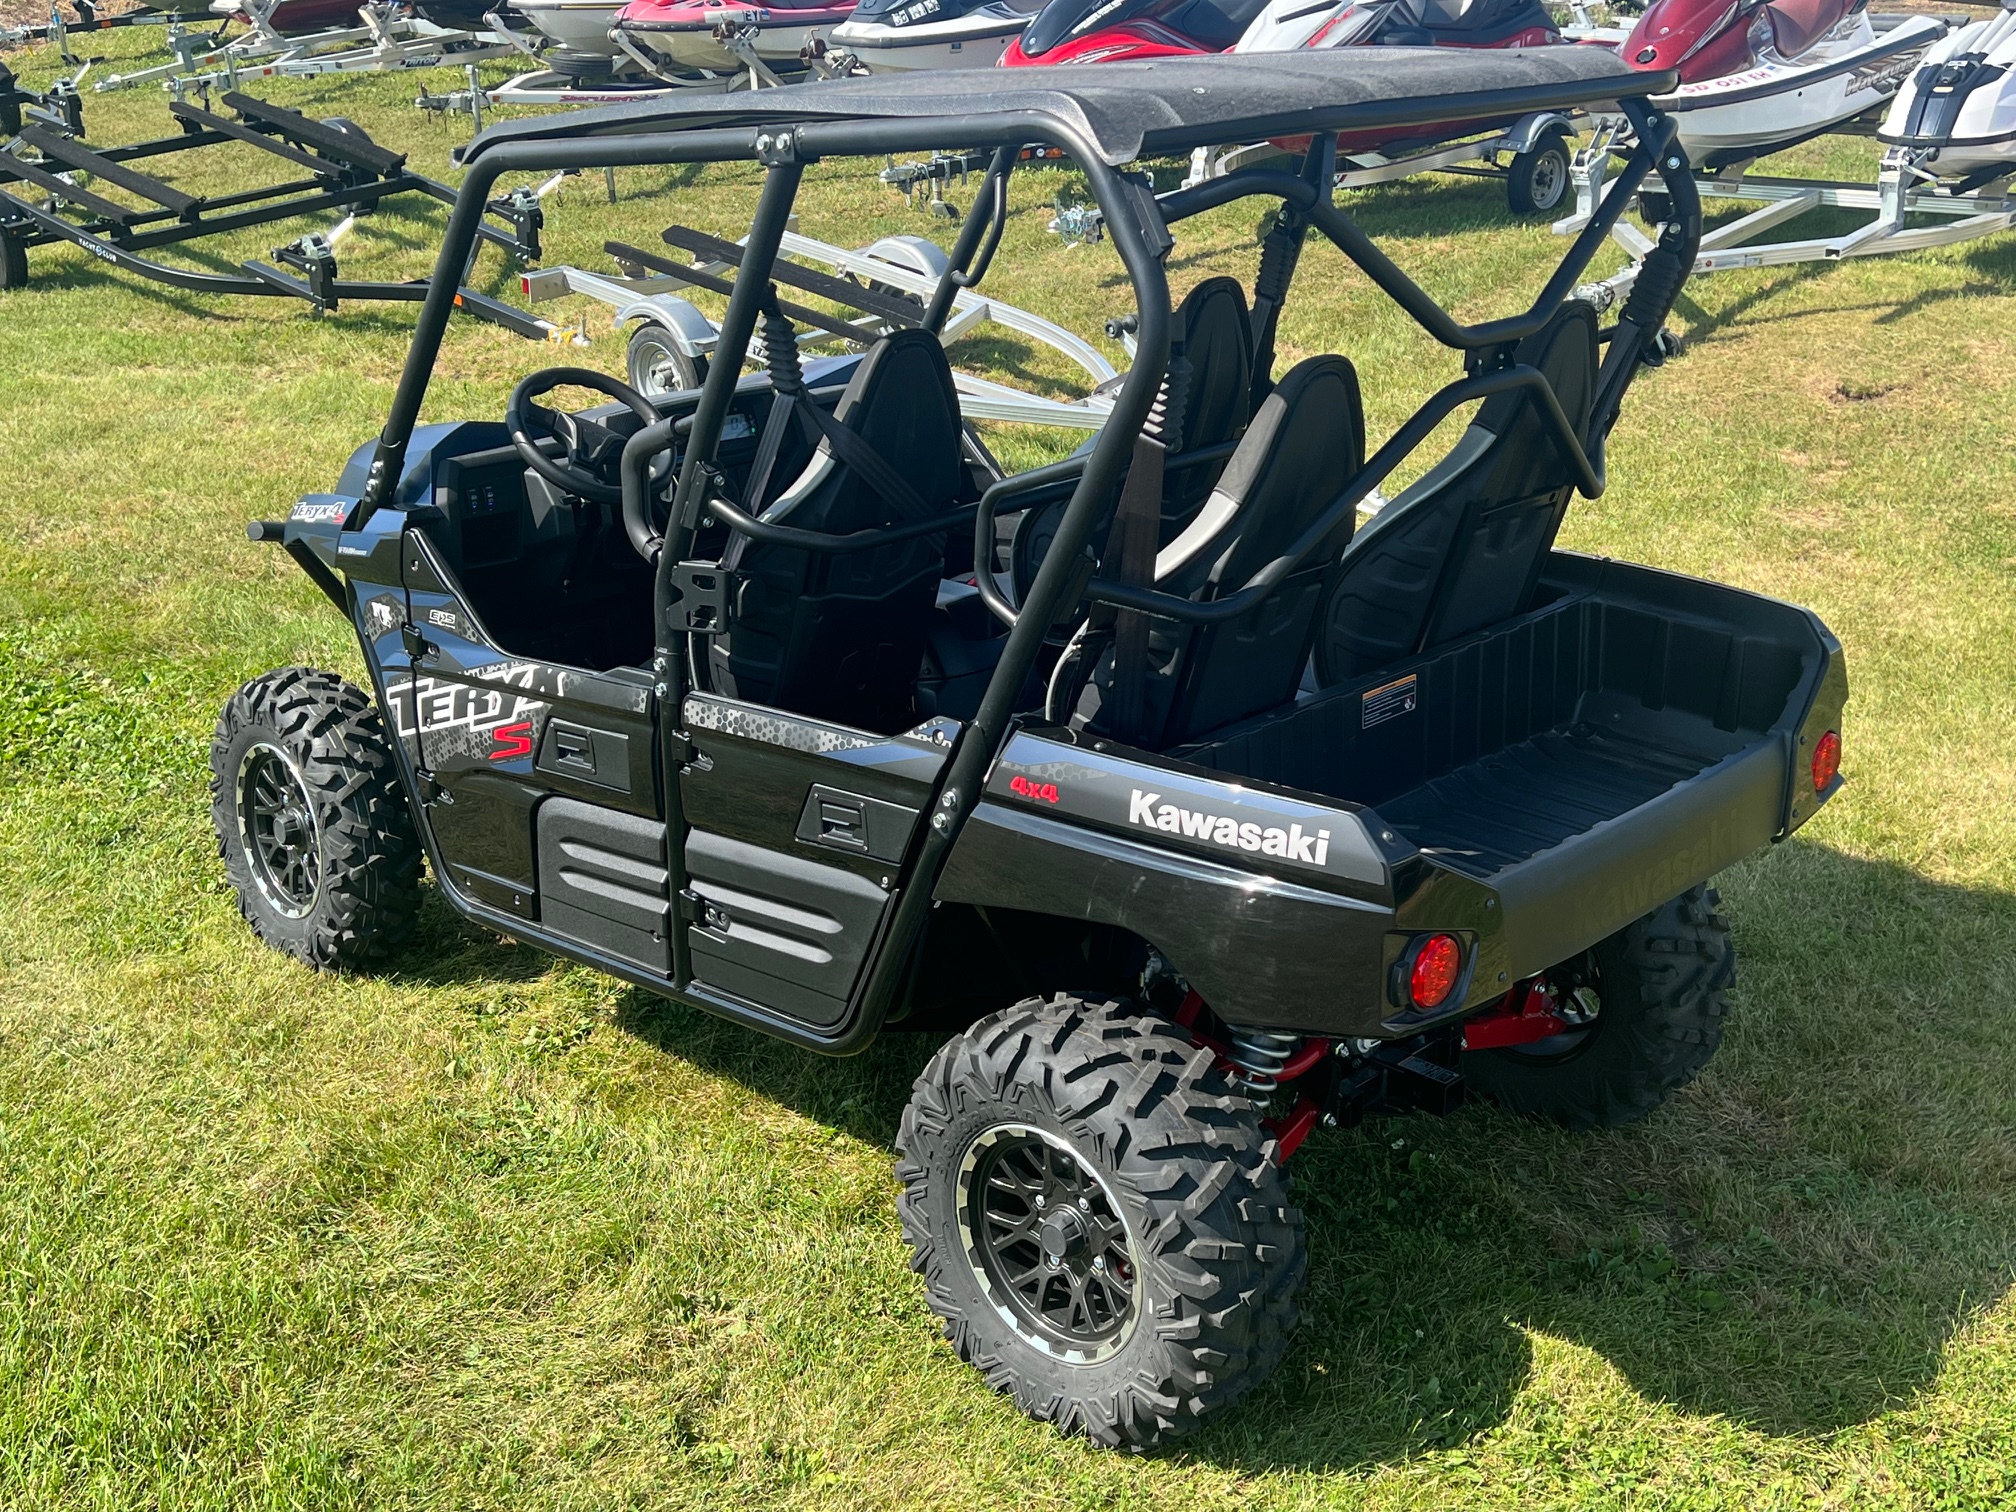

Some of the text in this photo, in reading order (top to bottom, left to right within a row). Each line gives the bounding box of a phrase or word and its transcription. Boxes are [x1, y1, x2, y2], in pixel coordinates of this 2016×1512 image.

[745, 10, 758, 21] EY
[1682, 84, 1709, 93] SD
[430, 609, 456, 624] EPS
[1010, 776, 1060, 803] 4x4
[1128, 789, 1331, 866] Kawasaki
